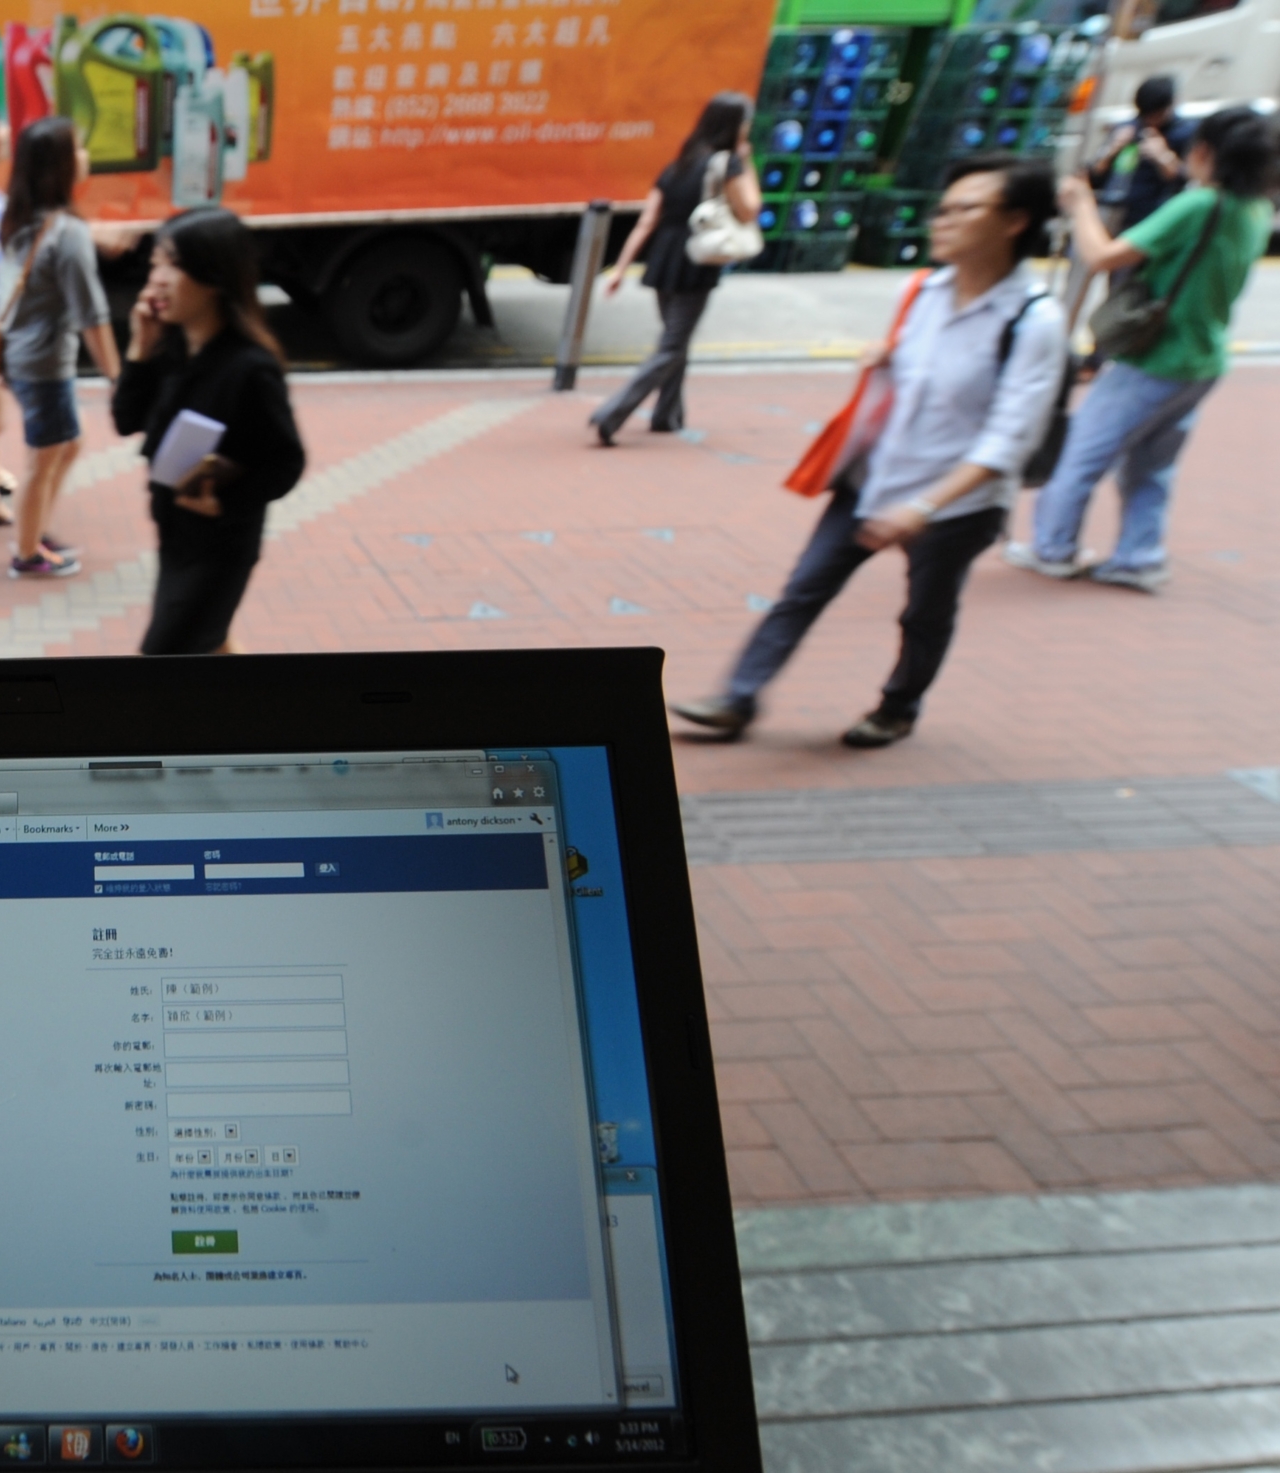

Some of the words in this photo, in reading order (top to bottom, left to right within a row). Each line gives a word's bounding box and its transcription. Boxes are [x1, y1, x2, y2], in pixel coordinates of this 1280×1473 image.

[447, 817, 478, 827] antony
[480, 815, 516, 825] dickson
[23, 823, 73, 834] Bookmarks
[94, 823, 118, 833] More
[624, 1382, 650, 1392] ancel
[445, 1431, 460, 1443] EN
